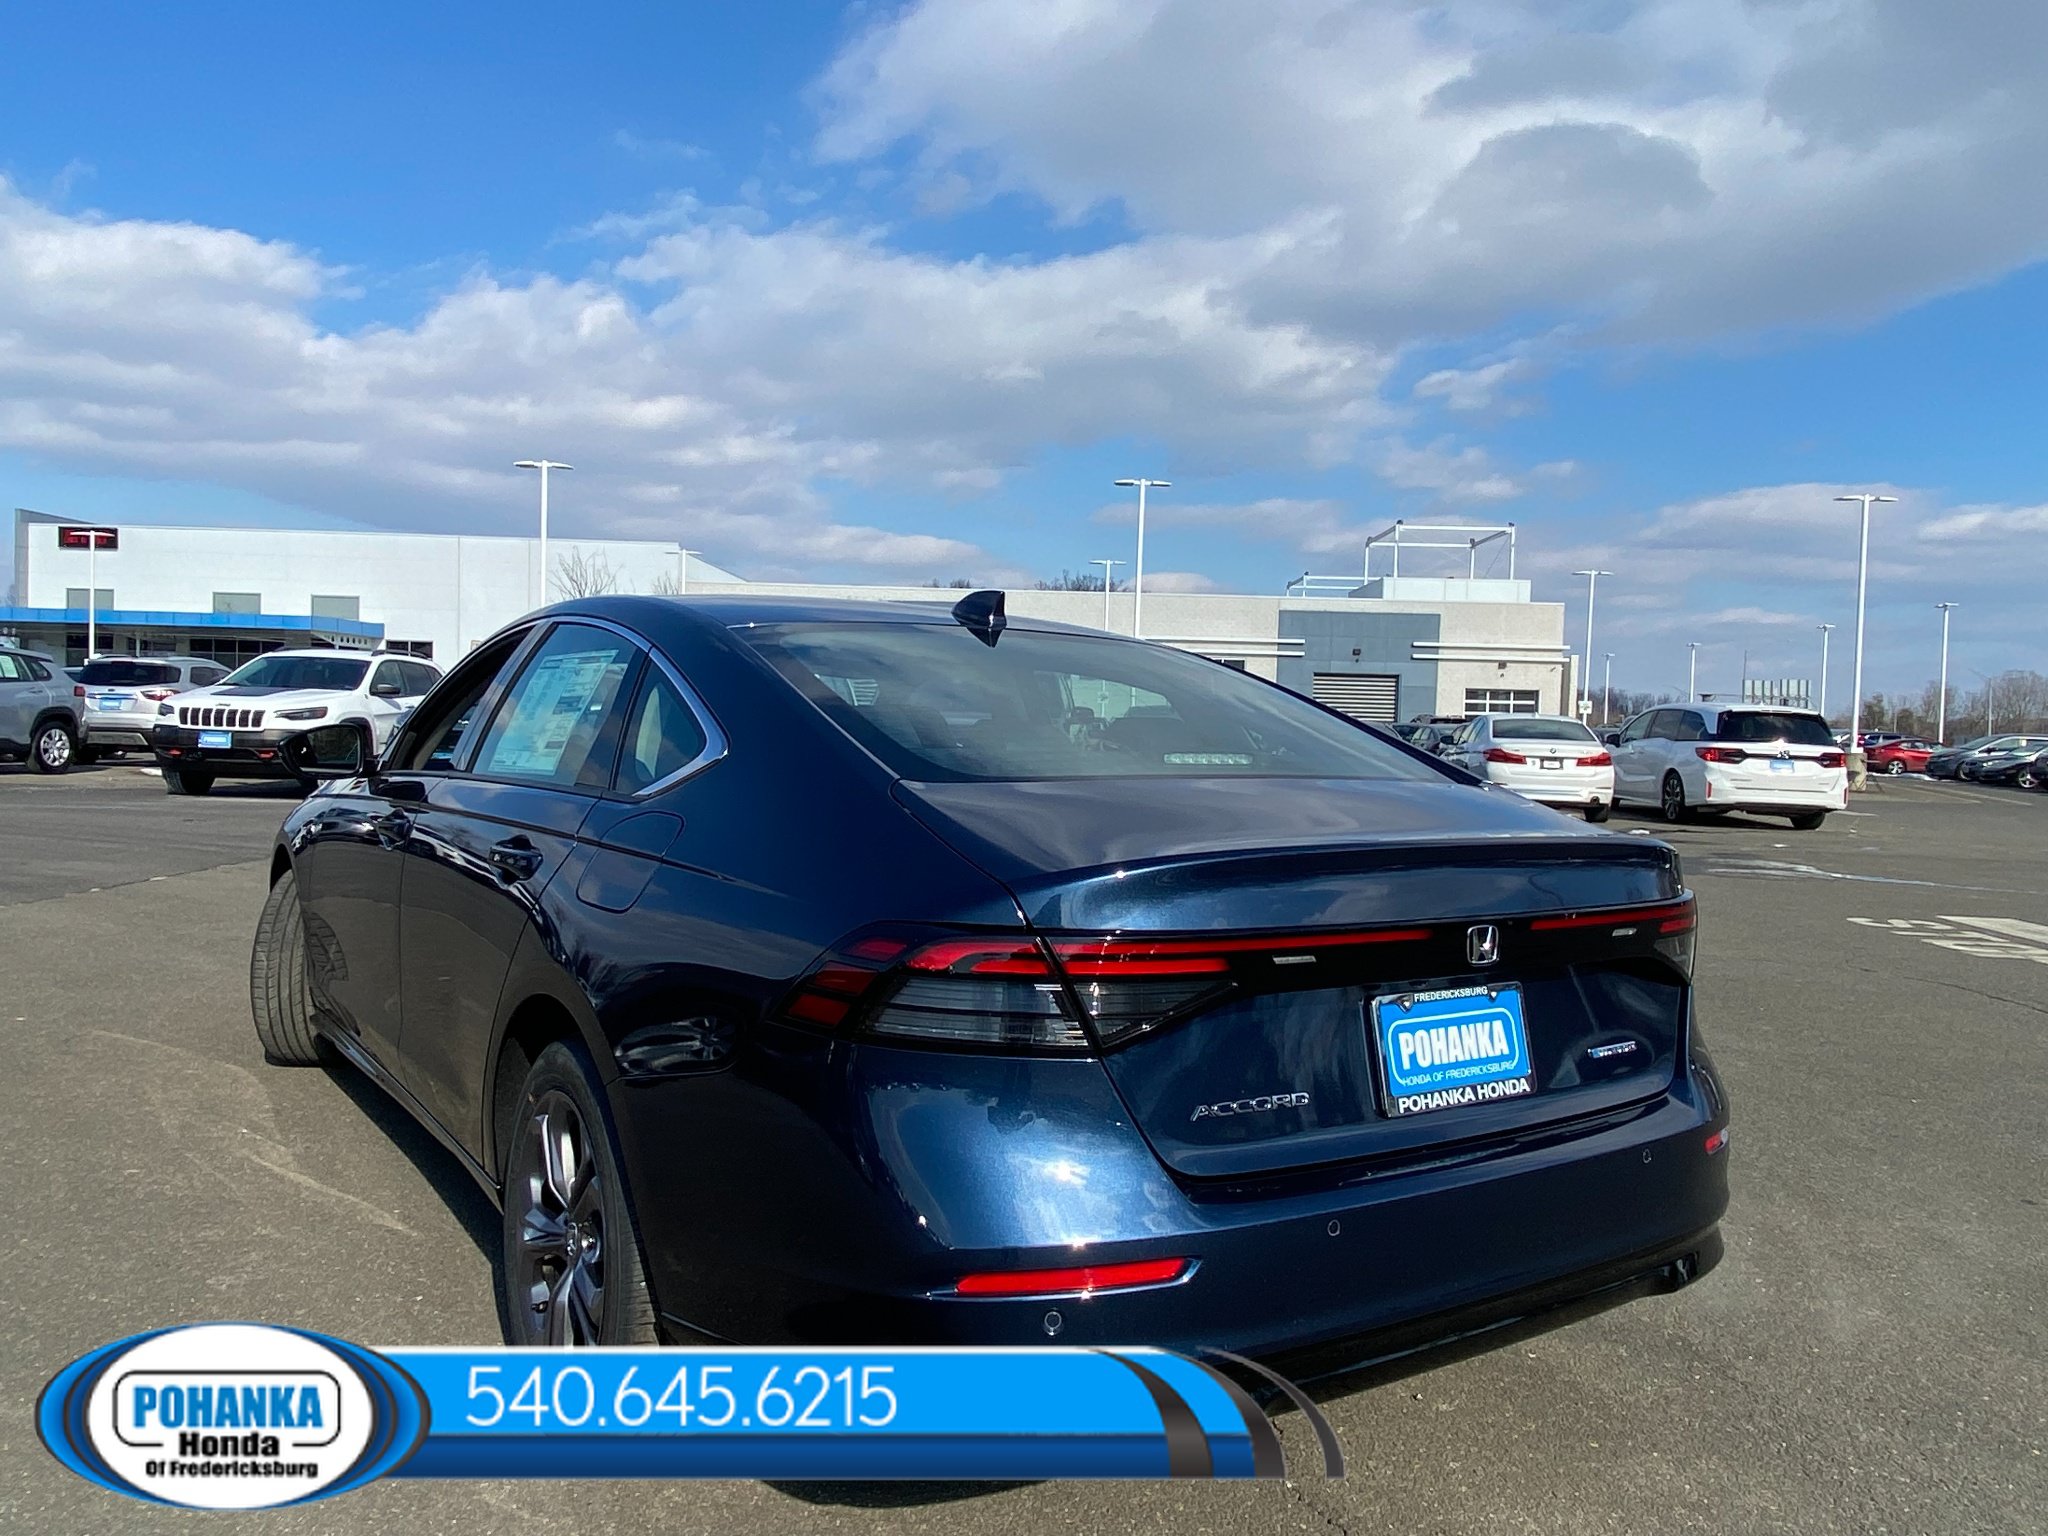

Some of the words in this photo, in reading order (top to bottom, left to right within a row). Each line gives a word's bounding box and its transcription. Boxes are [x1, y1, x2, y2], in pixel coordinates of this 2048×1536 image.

[1414, 986, 1488, 1003] FREDERICKSBURG
[1398, 1019, 1510, 1071] POHANKA
[1402, 1075, 1431, 1087] HONDA
[1433, 1070, 1444, 1082] OF
[1445, 1060, 1514, 1080] FREDERICKSBURG
[1190, 1092, 1310, 1121] ACCORD
[1398, 1088, 1477, 1114] POHANKA
[1477, 1077, 1531, 1100] HONDA
